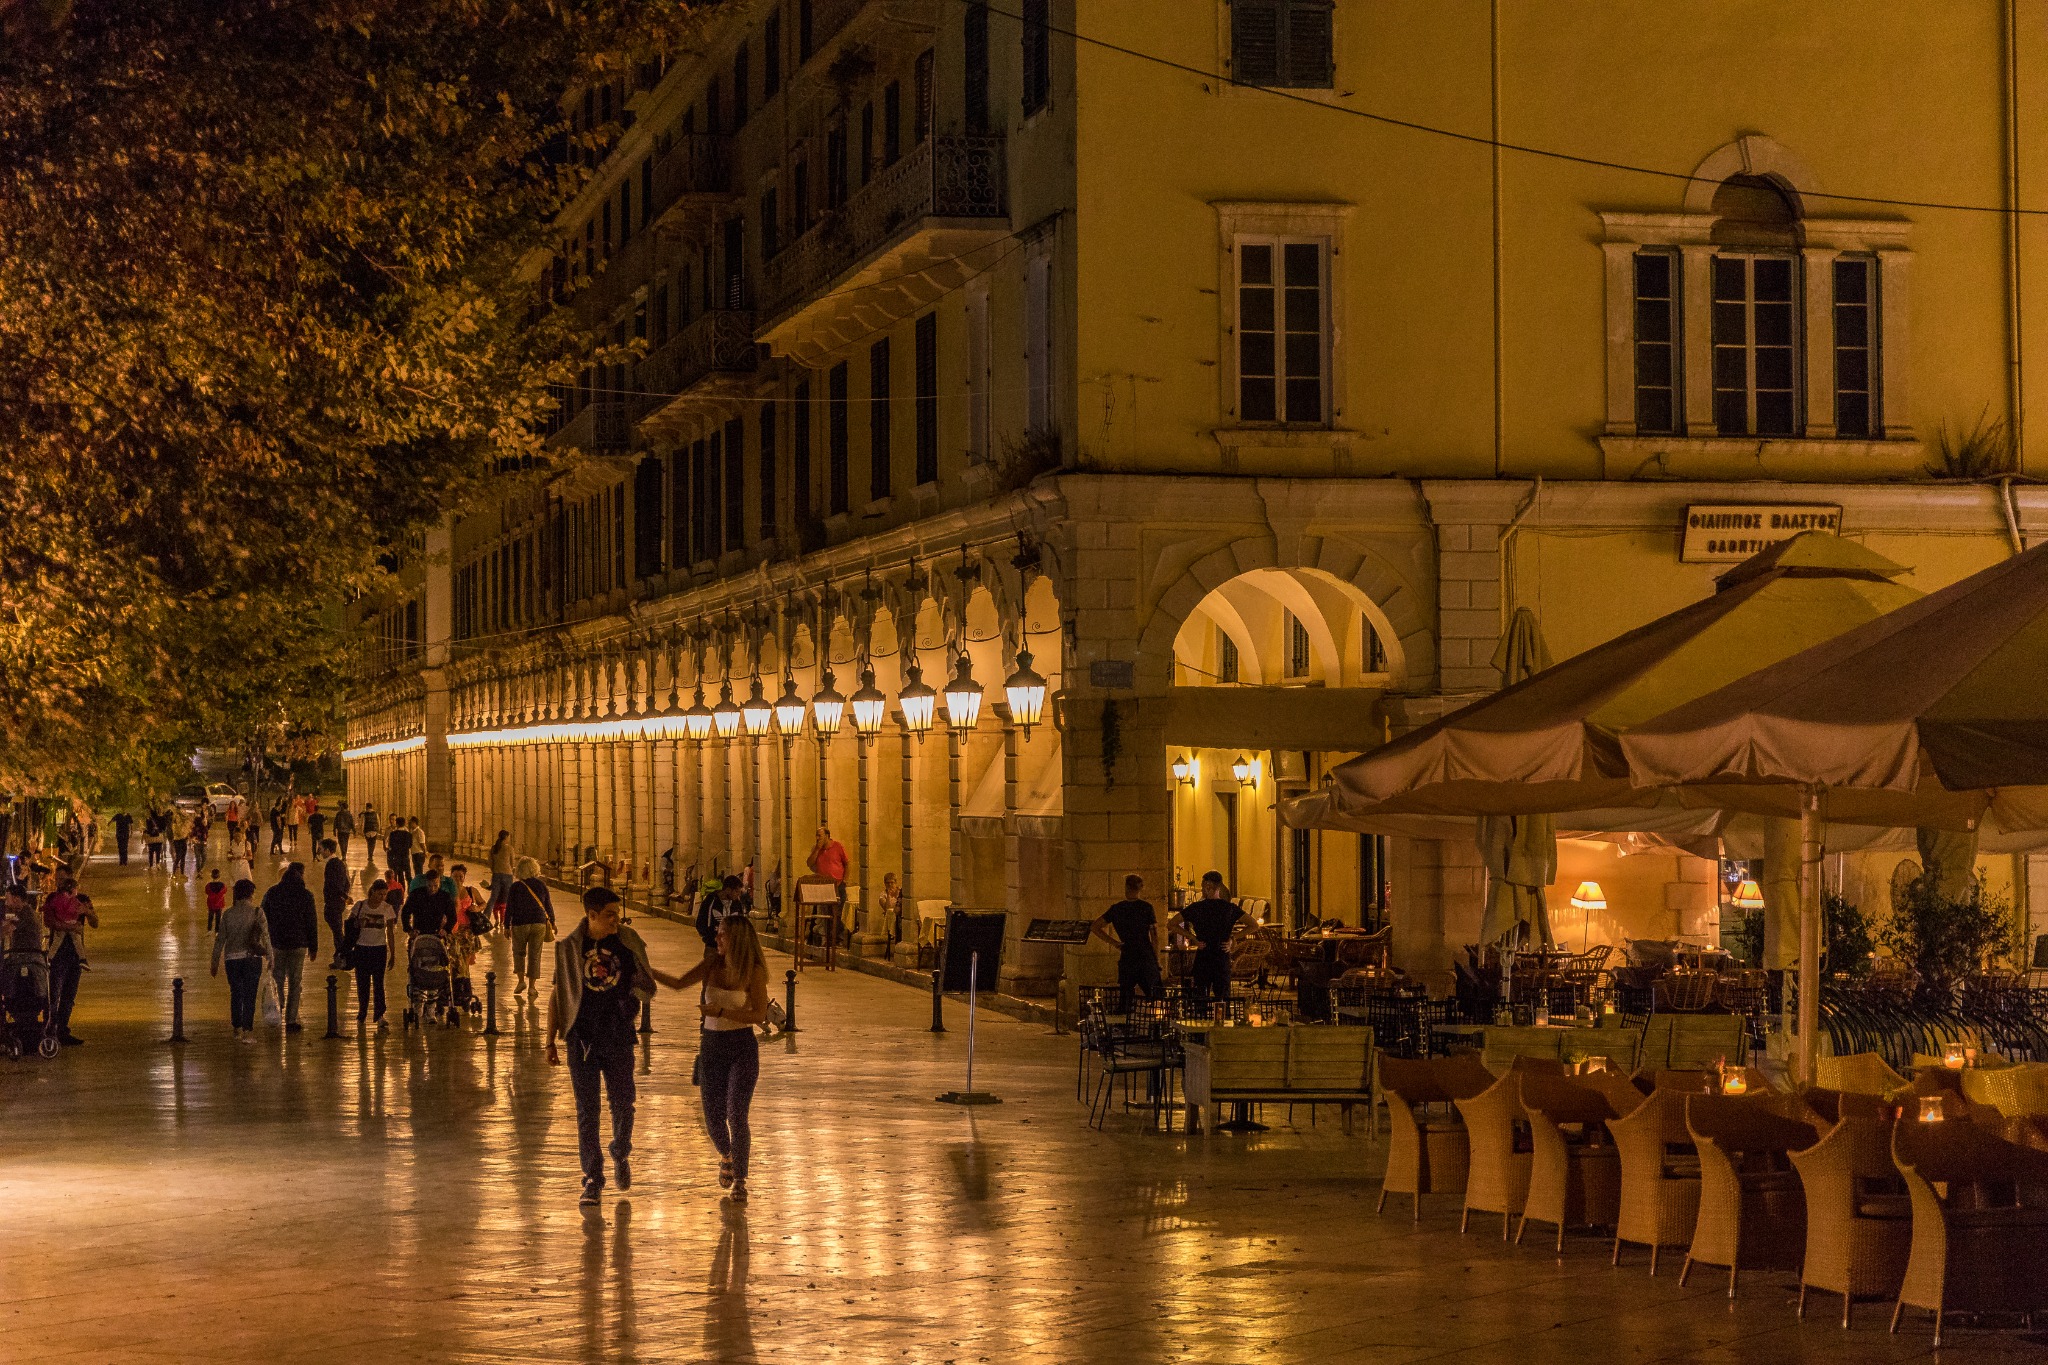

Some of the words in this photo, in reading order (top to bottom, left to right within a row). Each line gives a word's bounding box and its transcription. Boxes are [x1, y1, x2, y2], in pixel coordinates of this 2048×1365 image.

[1689, 513, 1762, 530] ΦΙΛΙΠΠΟΣ
[1770, 513, 1837, 530] ΒΛΑΣΤΟΣ
[1708, 539, 1780, 553] ΟΔΟΝΤΙΑ
